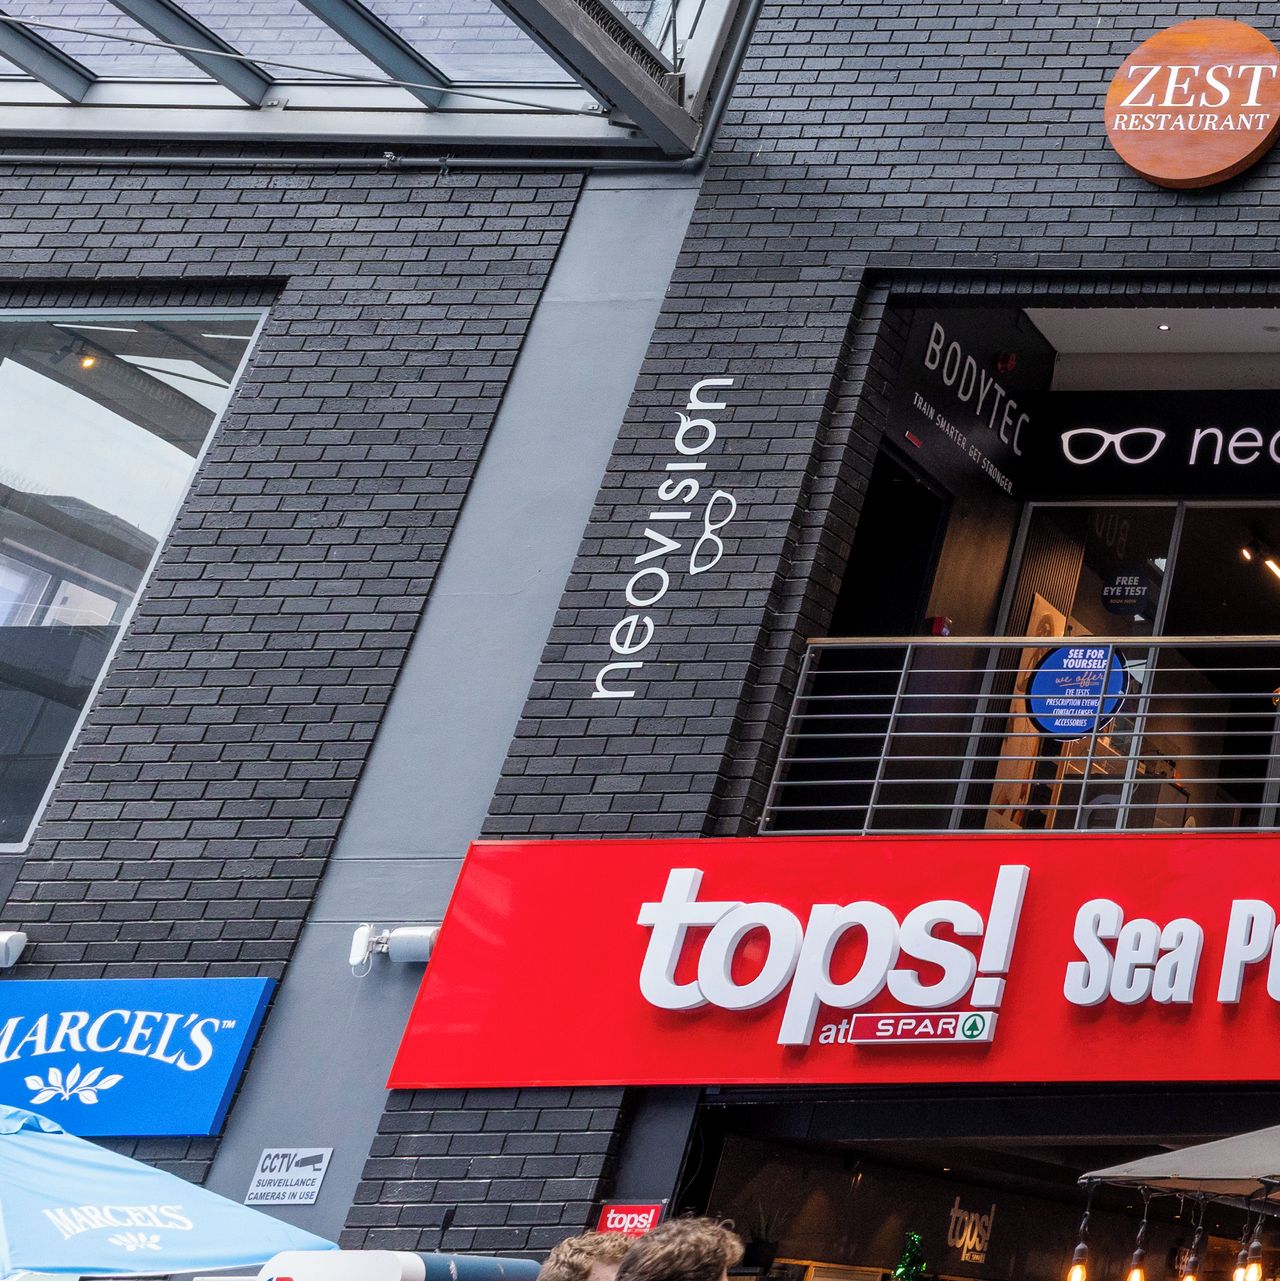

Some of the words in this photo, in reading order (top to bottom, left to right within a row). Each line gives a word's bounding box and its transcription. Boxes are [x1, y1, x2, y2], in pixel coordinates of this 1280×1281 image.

[1121, 64, 1277, 108] ZEST
[1113, 113, 1269, 132] RESTAURANT
[924, 322, 1030, 456] BODYTEC
[912, 391, 936, 420] TRAIN
[935, 413, 968, 452] SMARTER.
[968, 445, 981, 464] GET
[981, 457, 1014, 496] STRONGER.
[591, 377, 734, 699] neovision
[1115, 576, 1140, 585] FREE
[1103, 586, 1122, 596] EYE
[1124, 586, 1147, 596] TEST
[1067, 649, 1084, 658] SEE
[1086, 649, 1105, 658] FOR
[1063, 659, 1108, 669] YOURSELF
[1076, 671, 1106, 682] offer
[1081, 699, 1102, 707] EYEWEA
[1054, 719, 1087, 727] ACCESSORIES
[636, 865, 1030, 1046] tops!
[1062, 898, 1204, 1007] Sea
[818, 1019, 850, 1044] at
[875, 1018, 957, 1037] SPAR
[259, 1153, 297, 1174] CCTV
[256, 1178, 317, 1188] SURVEILLANCE
[247, 1191, 286, 1201] CAMERAS
[287, 1191, 297, 1200] IN
[298, 1191, 315, 1200] USE
[42, 1205, 194, 1240] MARCEL'S
[606, 1209, 656, 1232] tops!
